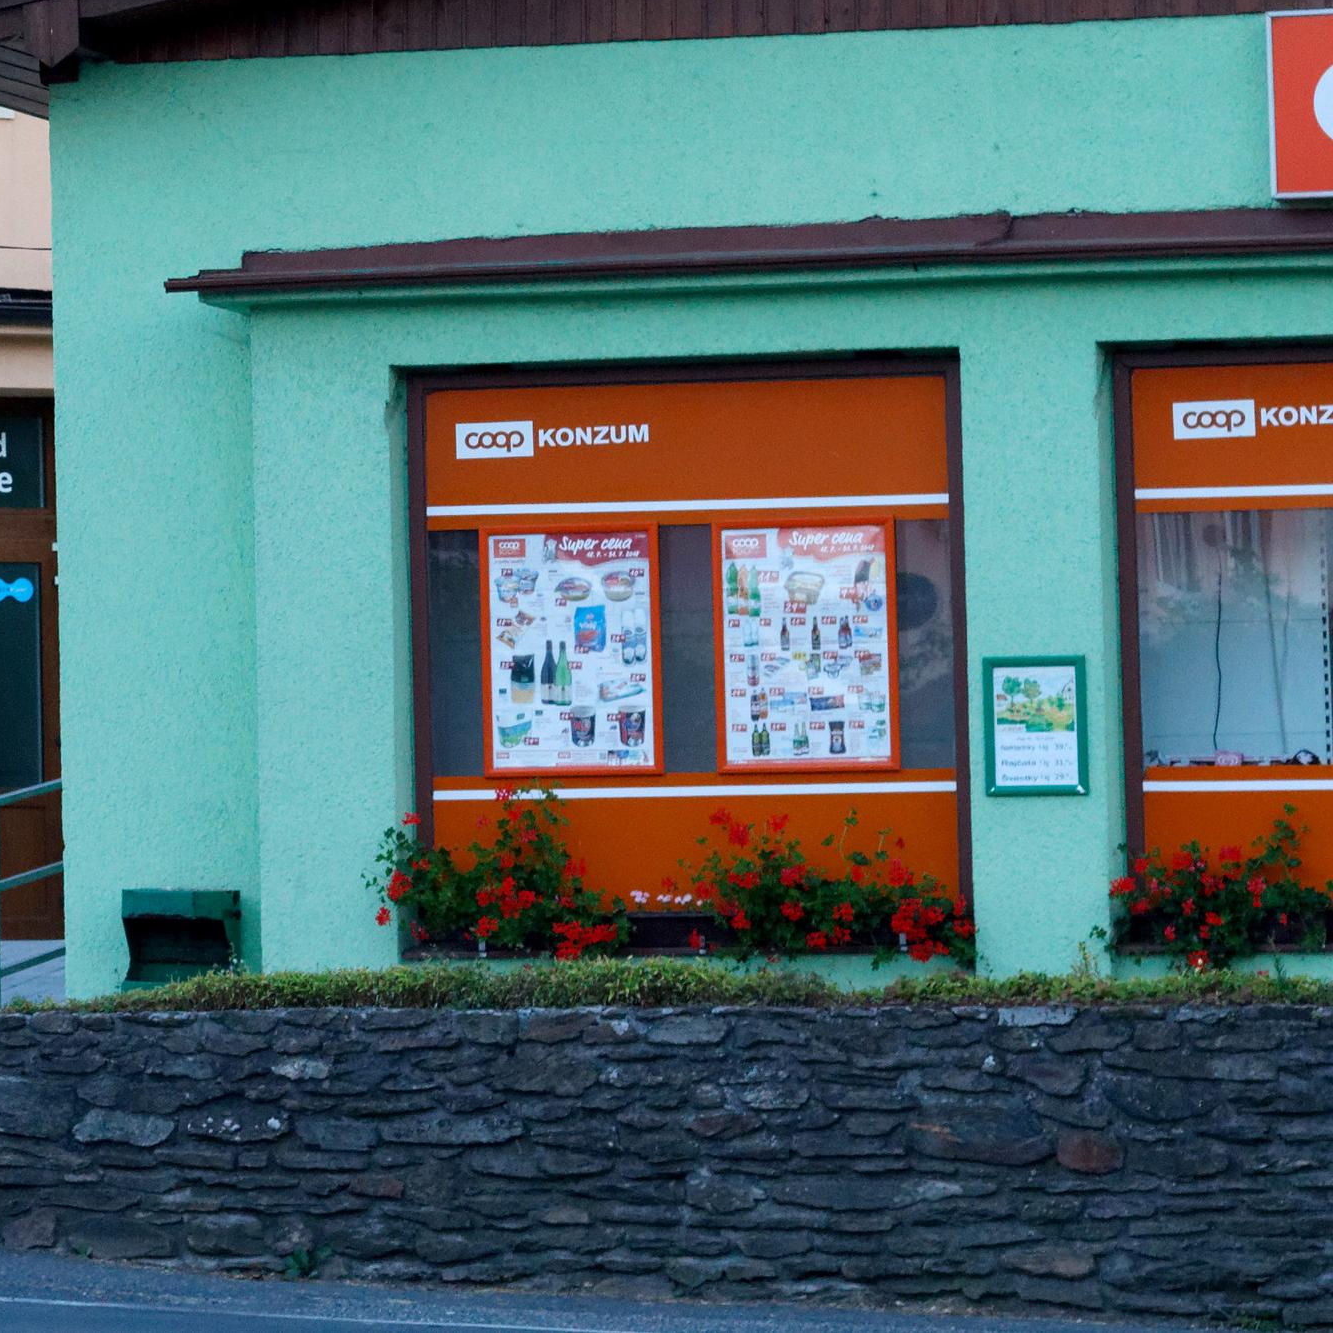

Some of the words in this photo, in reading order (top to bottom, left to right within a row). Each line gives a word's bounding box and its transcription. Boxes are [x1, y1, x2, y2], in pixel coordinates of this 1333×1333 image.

[1183, 409, 1246, 432] coop
[465, 429, 525, 453] coop
[538, 423, 650, 448] KONZUM
[559, 536, 597, 555] Super
[601, 538, 632, 550] cena
[789, 531, 830, 551] Super
[831, 532, 864, 545] cena
